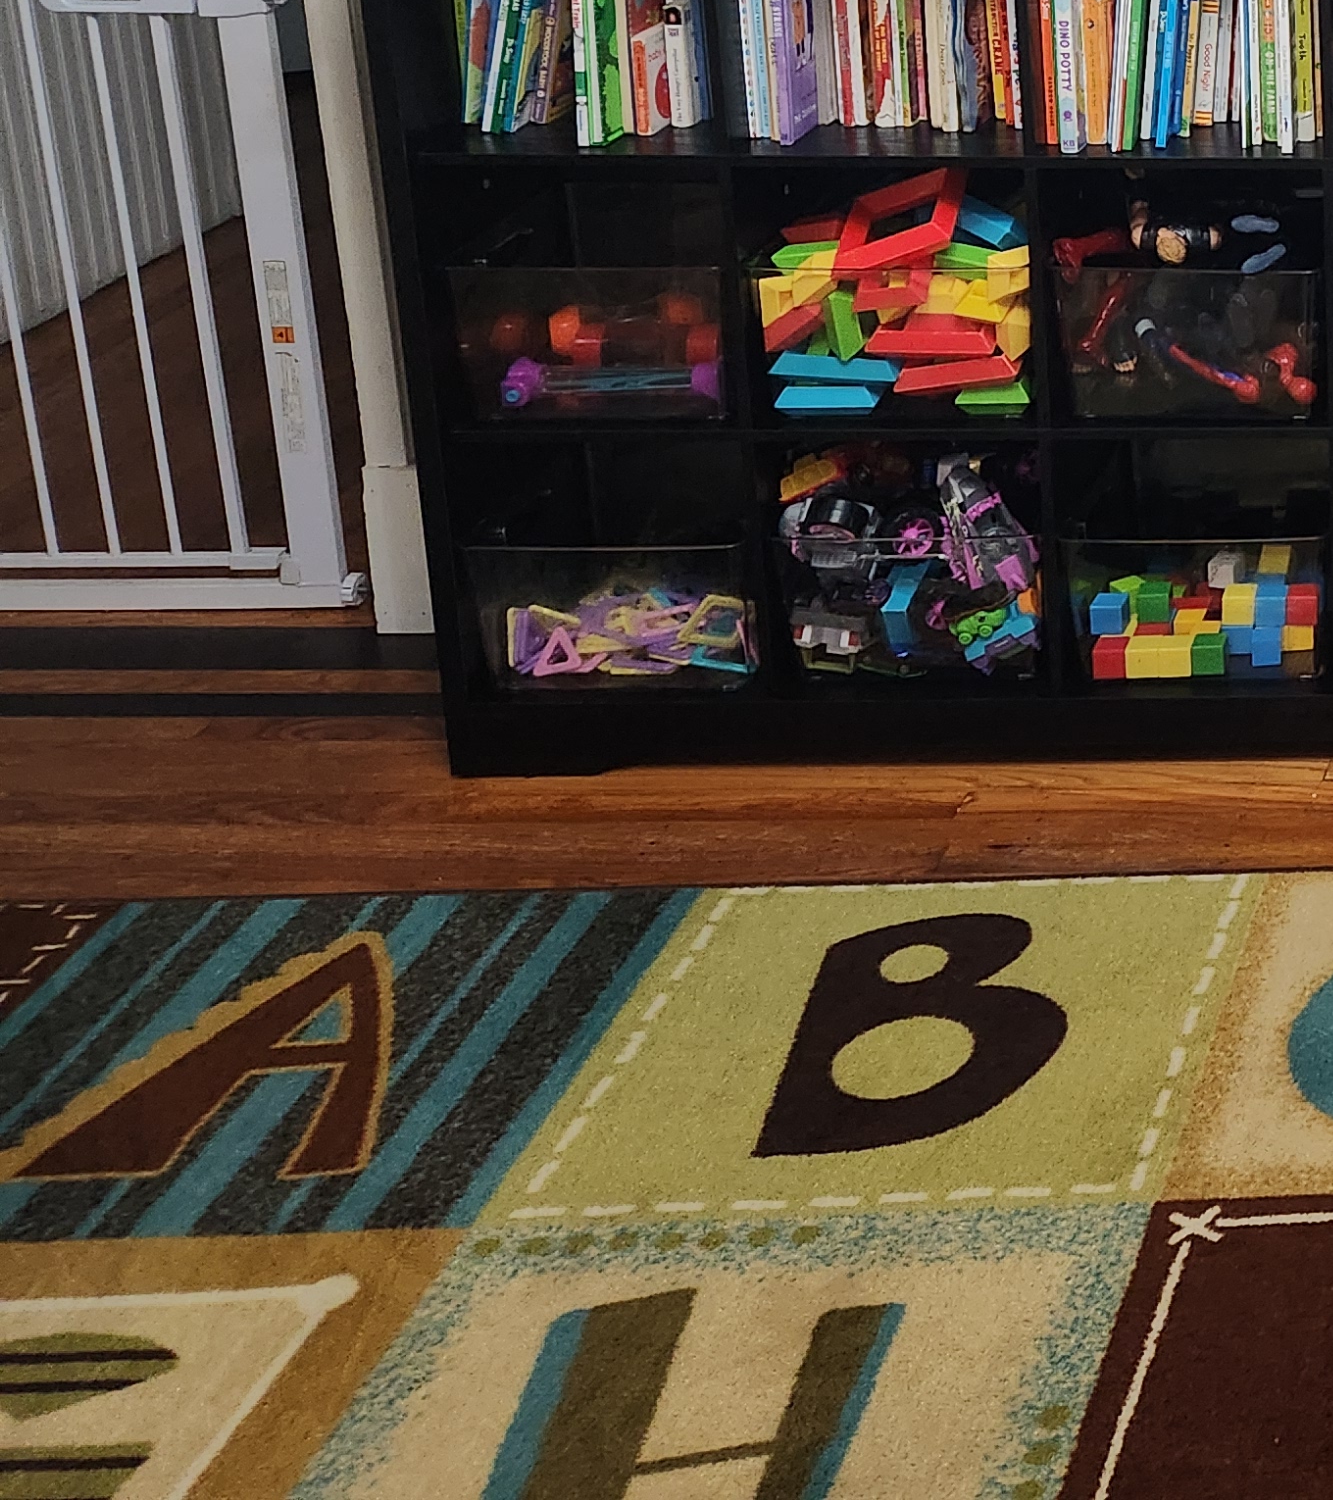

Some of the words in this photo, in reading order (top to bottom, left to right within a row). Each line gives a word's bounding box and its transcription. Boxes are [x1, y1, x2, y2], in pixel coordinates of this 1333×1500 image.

[572, 8, 582, 30] Train
[1058, 20, 1071, 49] DINO
[1299, 33, 1308, 61] Tooth
[991, 39, 1004, 75] CRANE
[1186, 44, 1195, 63] Puppy
[1203, 43, 1213, 68] Good
[1060, 52, 1073, 93] POTTY
[1200, 69, 1212, 93] Night
[752, 914, 1069, 1158] B
[5, 934, 393, 1181] A
